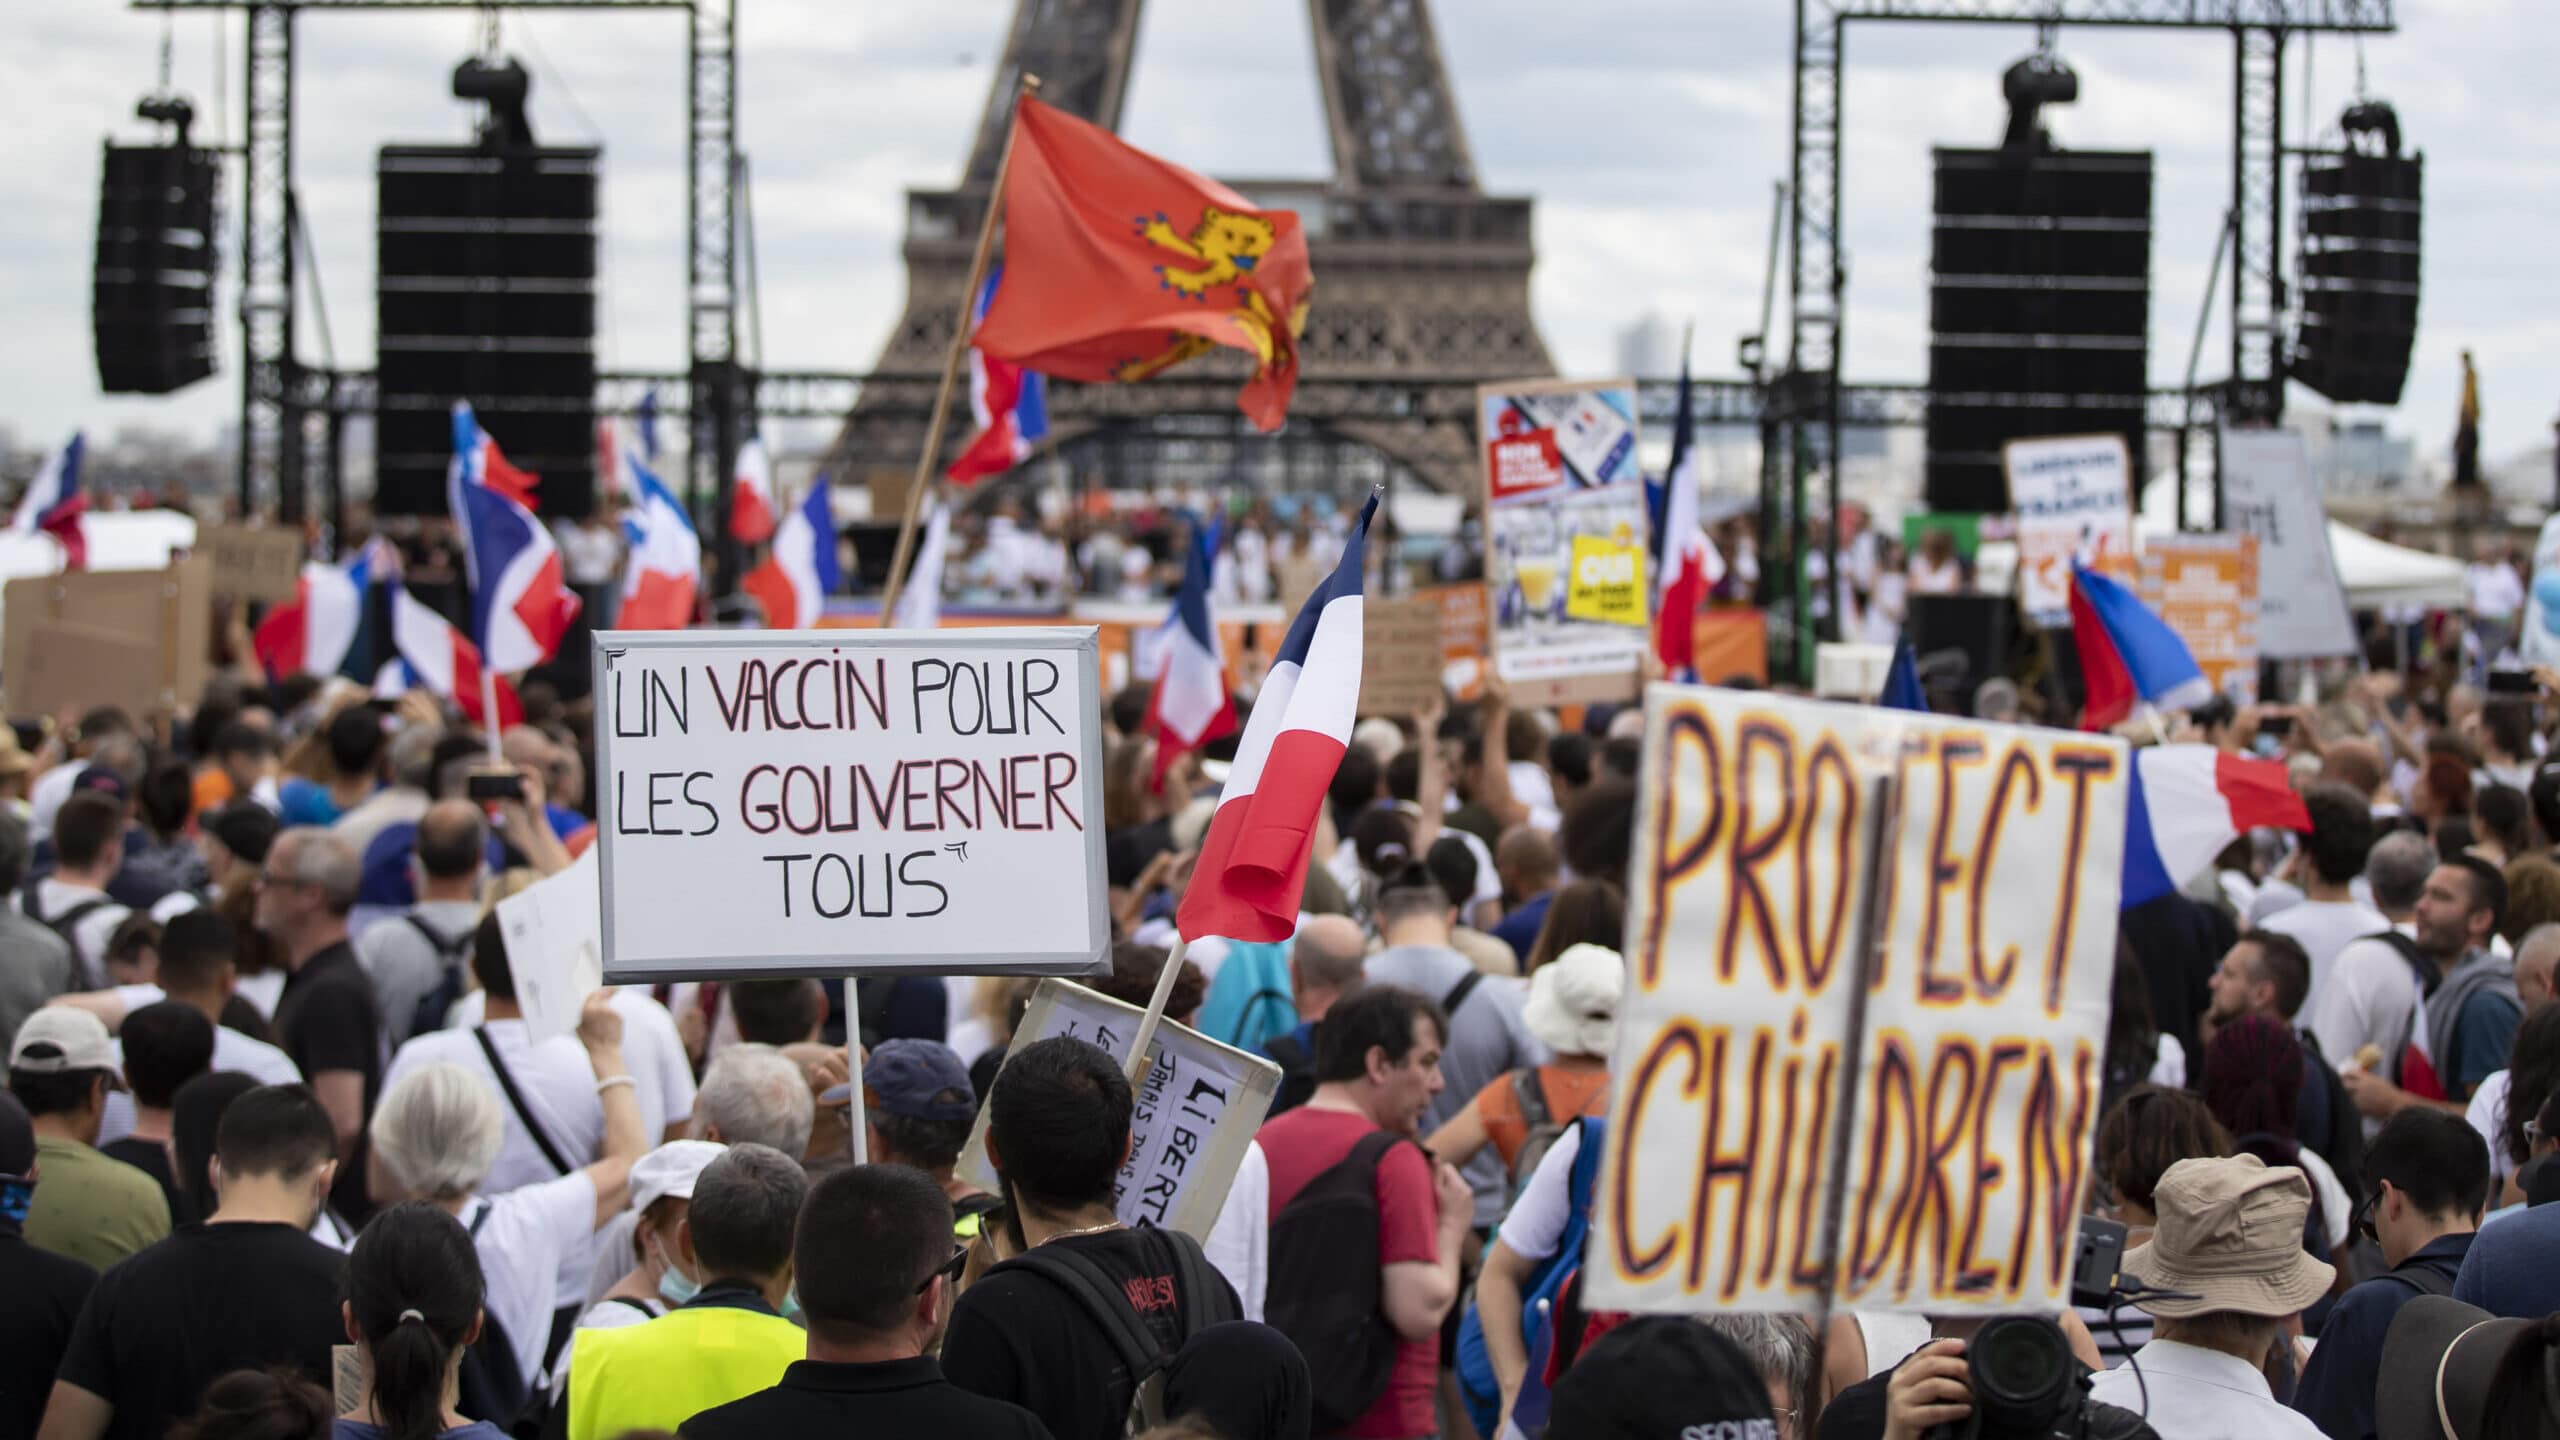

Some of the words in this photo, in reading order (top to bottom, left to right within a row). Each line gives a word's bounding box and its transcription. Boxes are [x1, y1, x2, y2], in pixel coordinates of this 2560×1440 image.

[1579, 552, 1635, 586] OUI
[912, 657, 1066, 736] POUR
[617, 770, 720, 836] LES
[740, 751, 1084, 836] GOUVERNER
